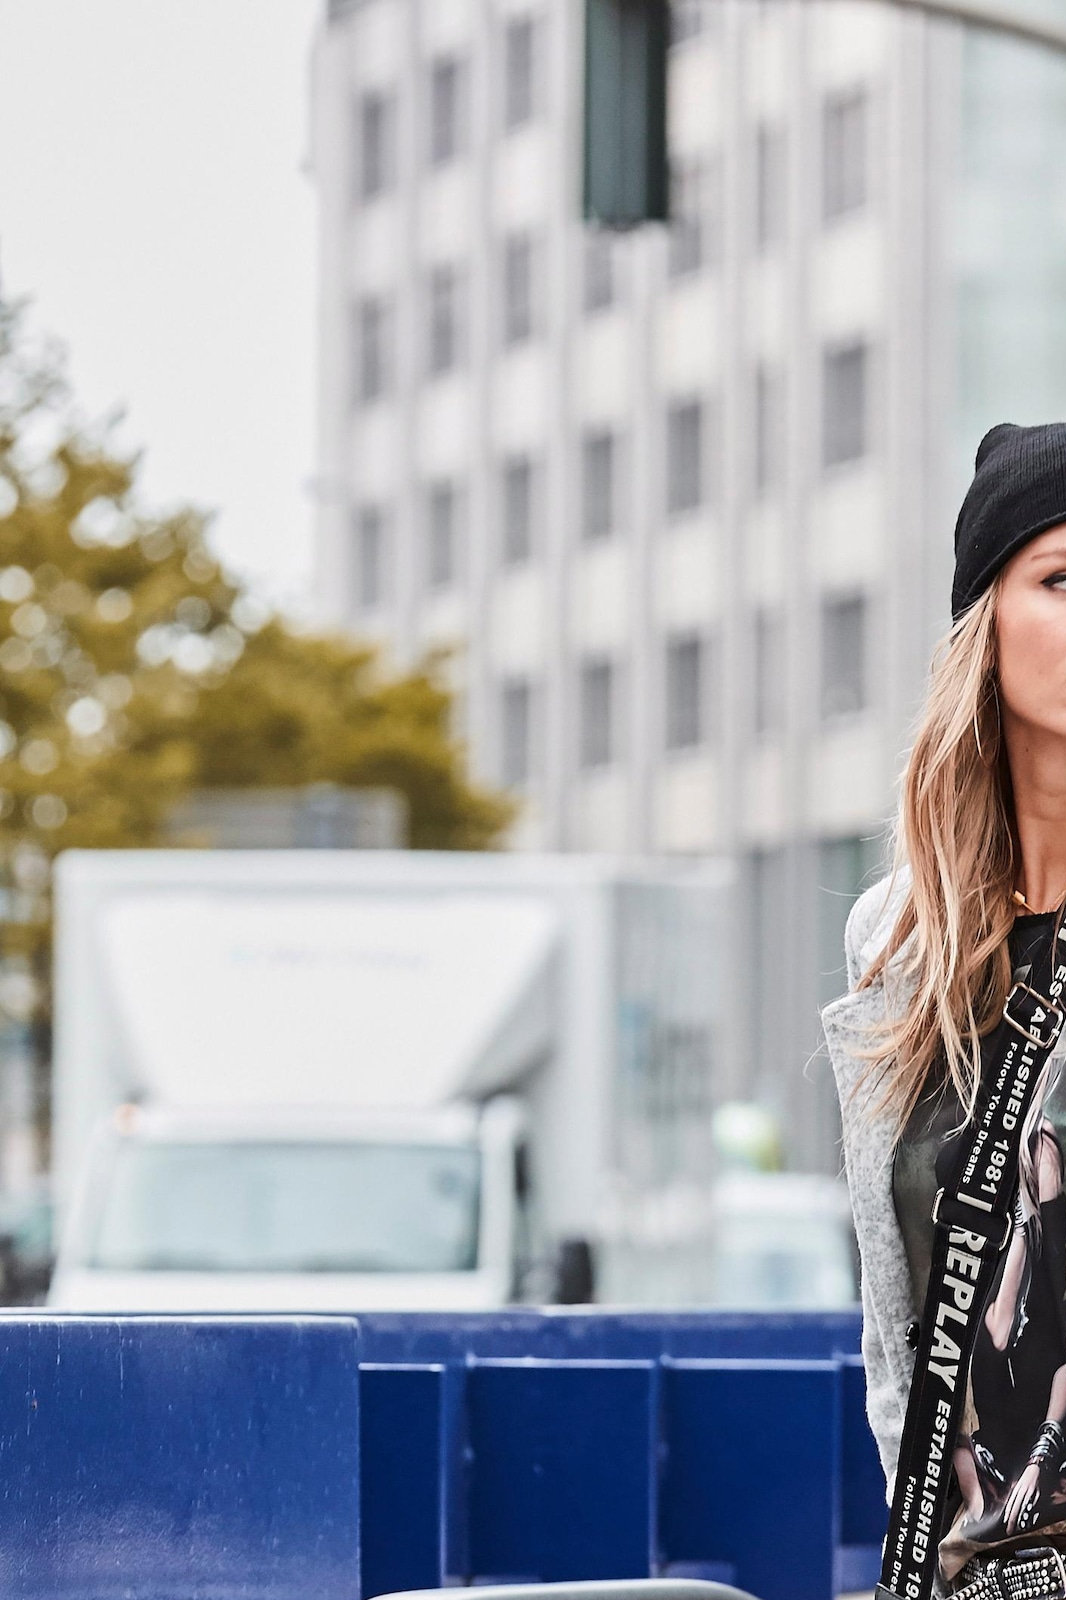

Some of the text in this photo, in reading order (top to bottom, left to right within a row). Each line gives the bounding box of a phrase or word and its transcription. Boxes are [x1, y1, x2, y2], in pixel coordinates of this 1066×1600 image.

[962, 1041, 1019, 1184] Follow Your Dreams
[980, 1139, 1010, 1195] 1981
[927, 1224, 988, 1393] REPLAY
[901, 1475, 917, 1523] Follow
[912, 1399, 951, 1564] ESTABLISHED
[895, 1527, 909, 1559] Your
